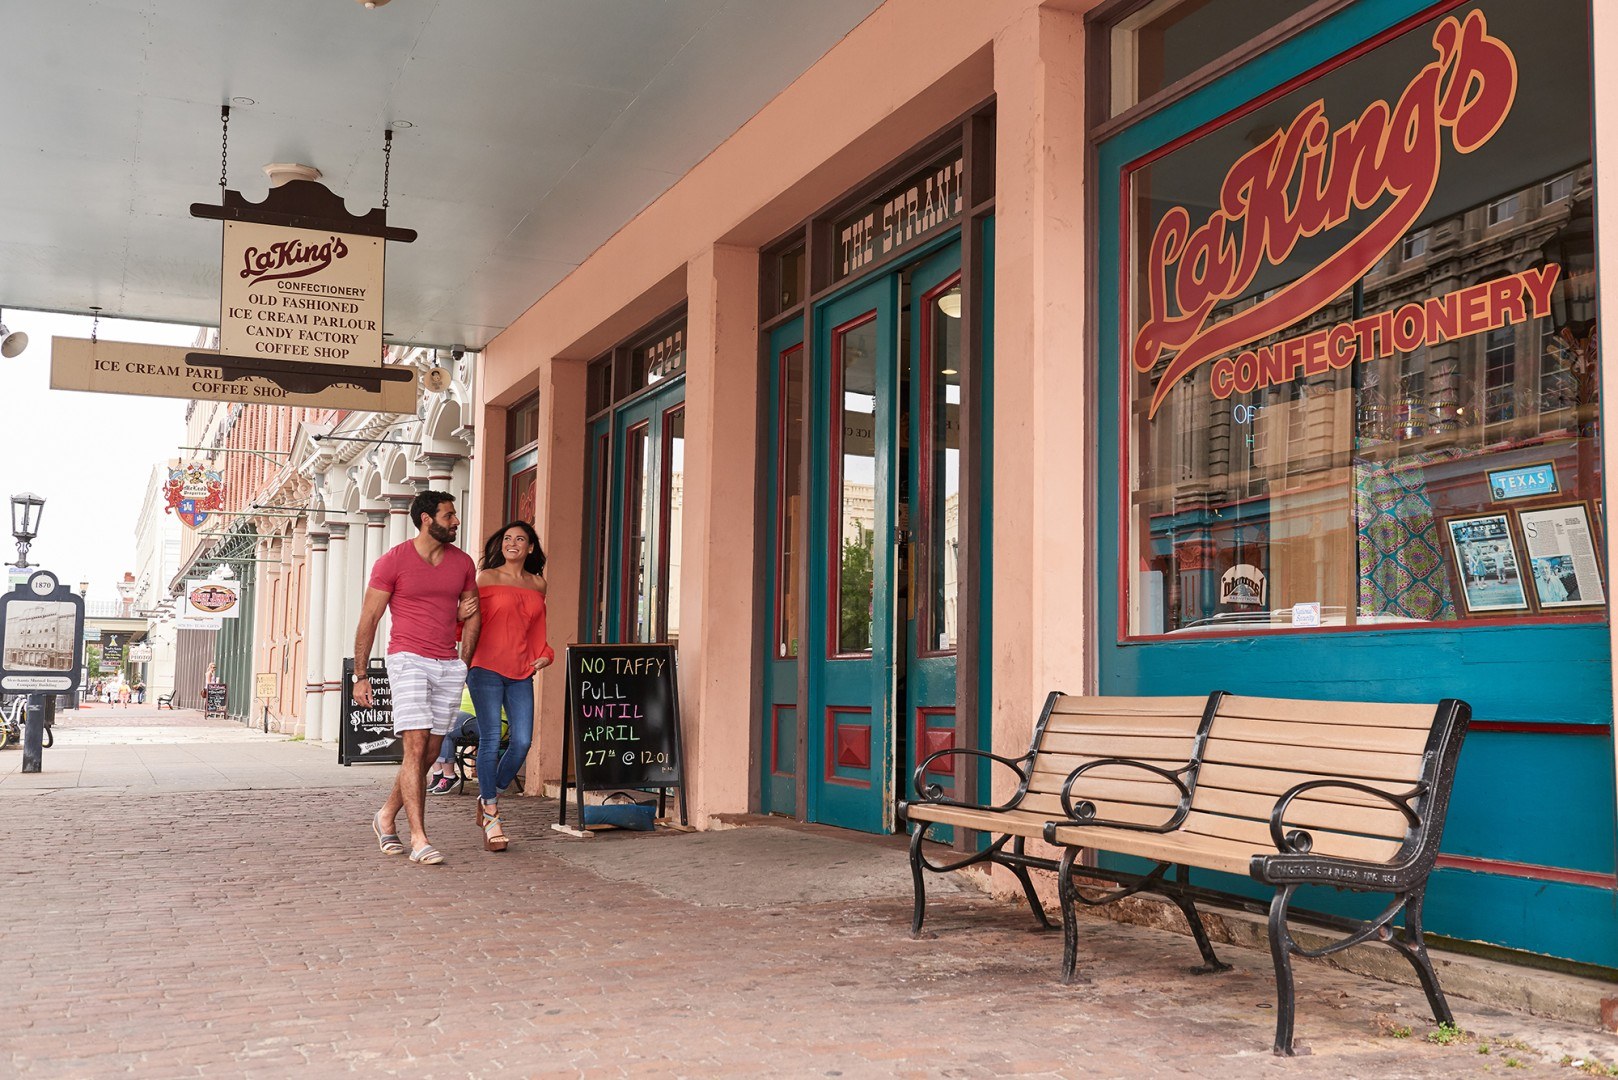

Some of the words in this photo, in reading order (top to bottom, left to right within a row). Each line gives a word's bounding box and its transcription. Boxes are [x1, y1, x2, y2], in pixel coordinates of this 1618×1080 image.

[1134, 8, 1517, 420] LaKing's
[842, 213, 874, 276] THE
[240, 236, 348, 287] LaKing's
[277, 280, 366, 297] CONFECTIONERY
[248, 293, 278, 307] OLD
[282, 297, 359, 314] FASHIONED
[228, 307, 253, 320] ICE
[257, 310, 308, 326] CREAM
[313, 315, 376, 332] PARLOUR
[246, 325, 294, 340] CANDY
[299, 329, 359, 346] FACTORY
[1210, 262, 1561, 399] CONFECTIONERY
[255, 341, 309, 356] COFFEE
[314, 345, 350, 360] SHOP
[94, 359, 120, 372] ICE
[125, 362, 180, 377] CREAM
[192, 381, 249, 395] COFFEE
[253, 385, 289, 398] SHOP
[1498, 472, 1546, 489] TEXAS
[581, 657, 605, 674] NO
[611, 657, 666, 677] TAFFY
[581, 681, 627, 699] PULL
[582, 703, 644, 718] UNTIL
[583, 725, 641, 742] APRIL
[364, 740, 388, 750] UPSTAIRS
[622, 751, 635, 765] @
